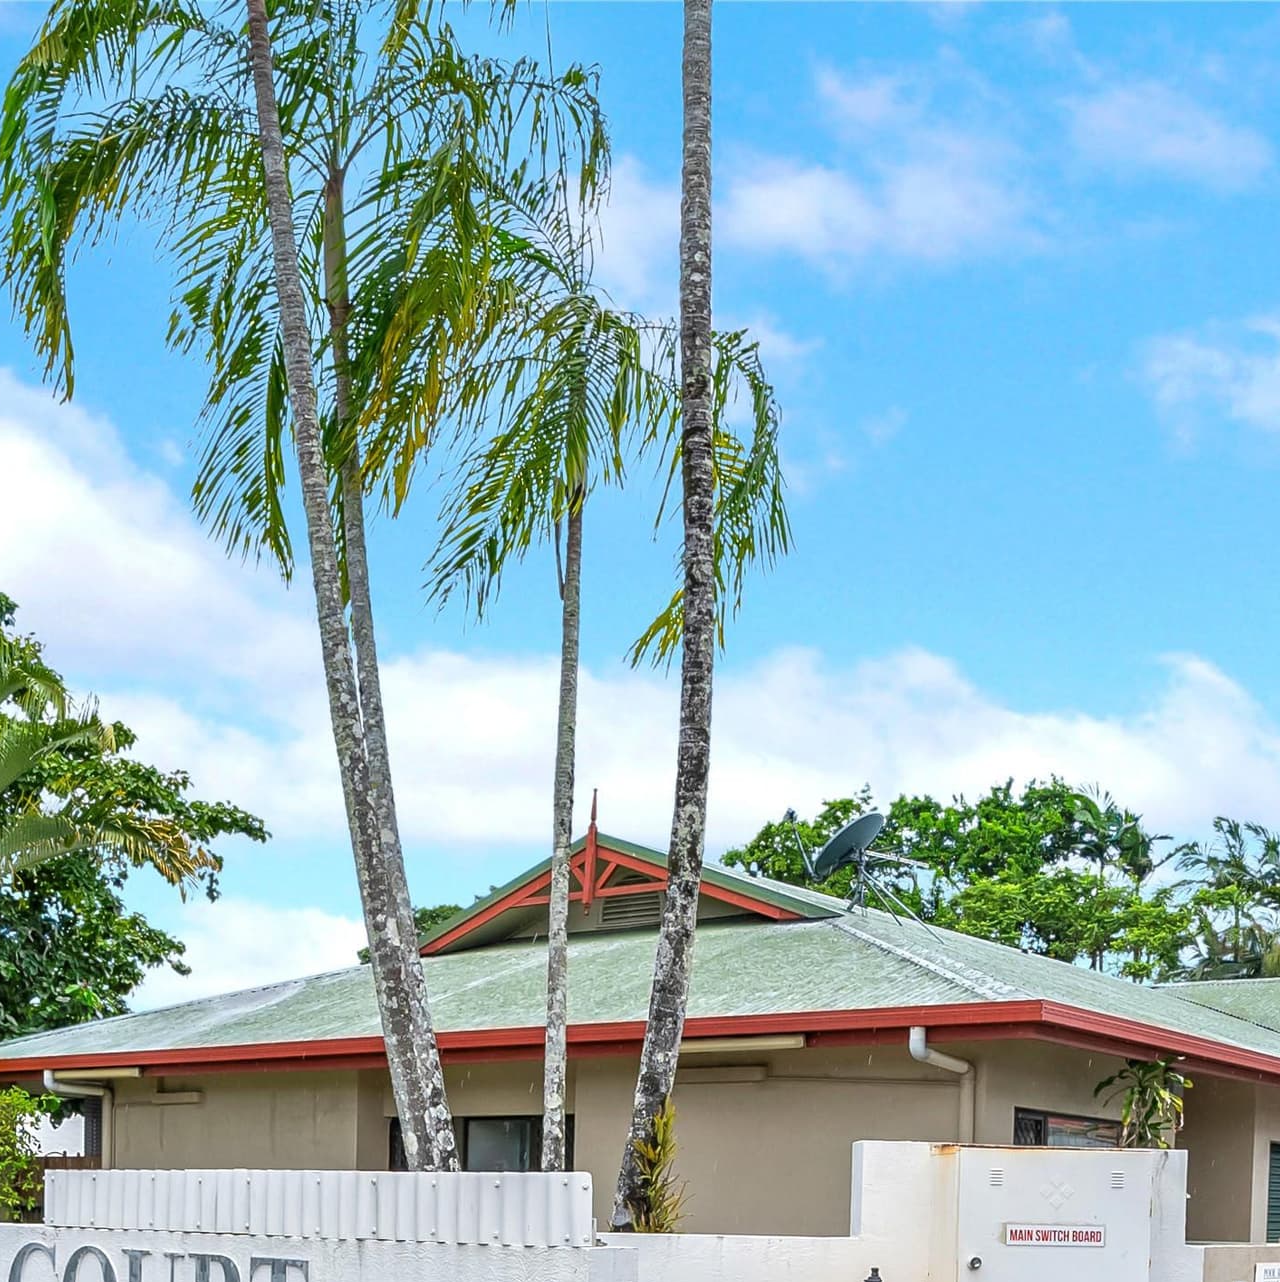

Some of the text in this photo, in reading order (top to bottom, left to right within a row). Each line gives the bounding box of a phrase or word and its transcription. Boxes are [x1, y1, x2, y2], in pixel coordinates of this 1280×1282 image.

[1010, 1229, 1102, 1243] MAIN SWITCH BOARD
